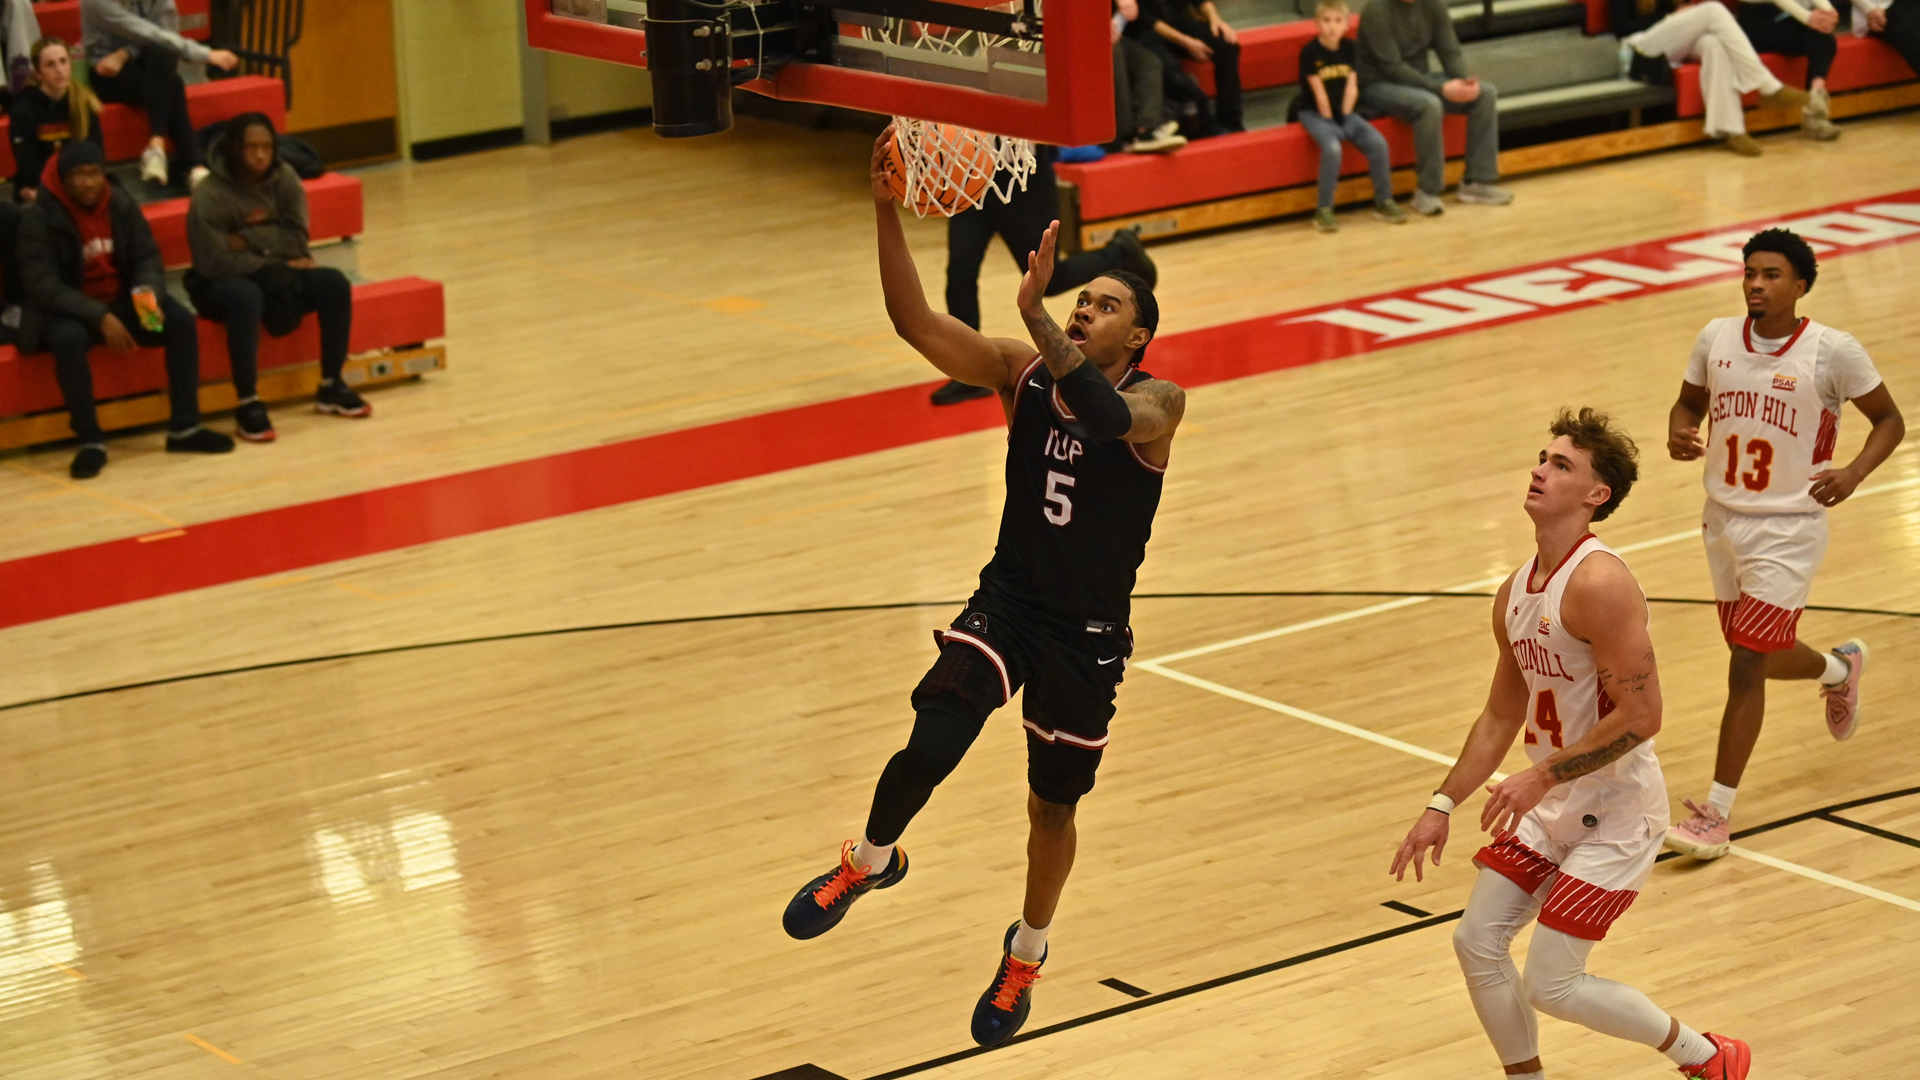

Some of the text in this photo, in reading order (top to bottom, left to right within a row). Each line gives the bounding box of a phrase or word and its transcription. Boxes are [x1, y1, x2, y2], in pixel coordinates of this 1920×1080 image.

[1275, 203, 1920, 343] WELCO
[1772, 377, 1797, 389] PSAC
[1761, 394, 1798, 438] HILL
[1044, 426, 1083, 466] IUP
[1724, 433, 1774, 492] 13
[1043, 469, 1076, 527] 5
[1538, 619, 1550, 632] SAC
[1512, 637, 1537, 671] TON
